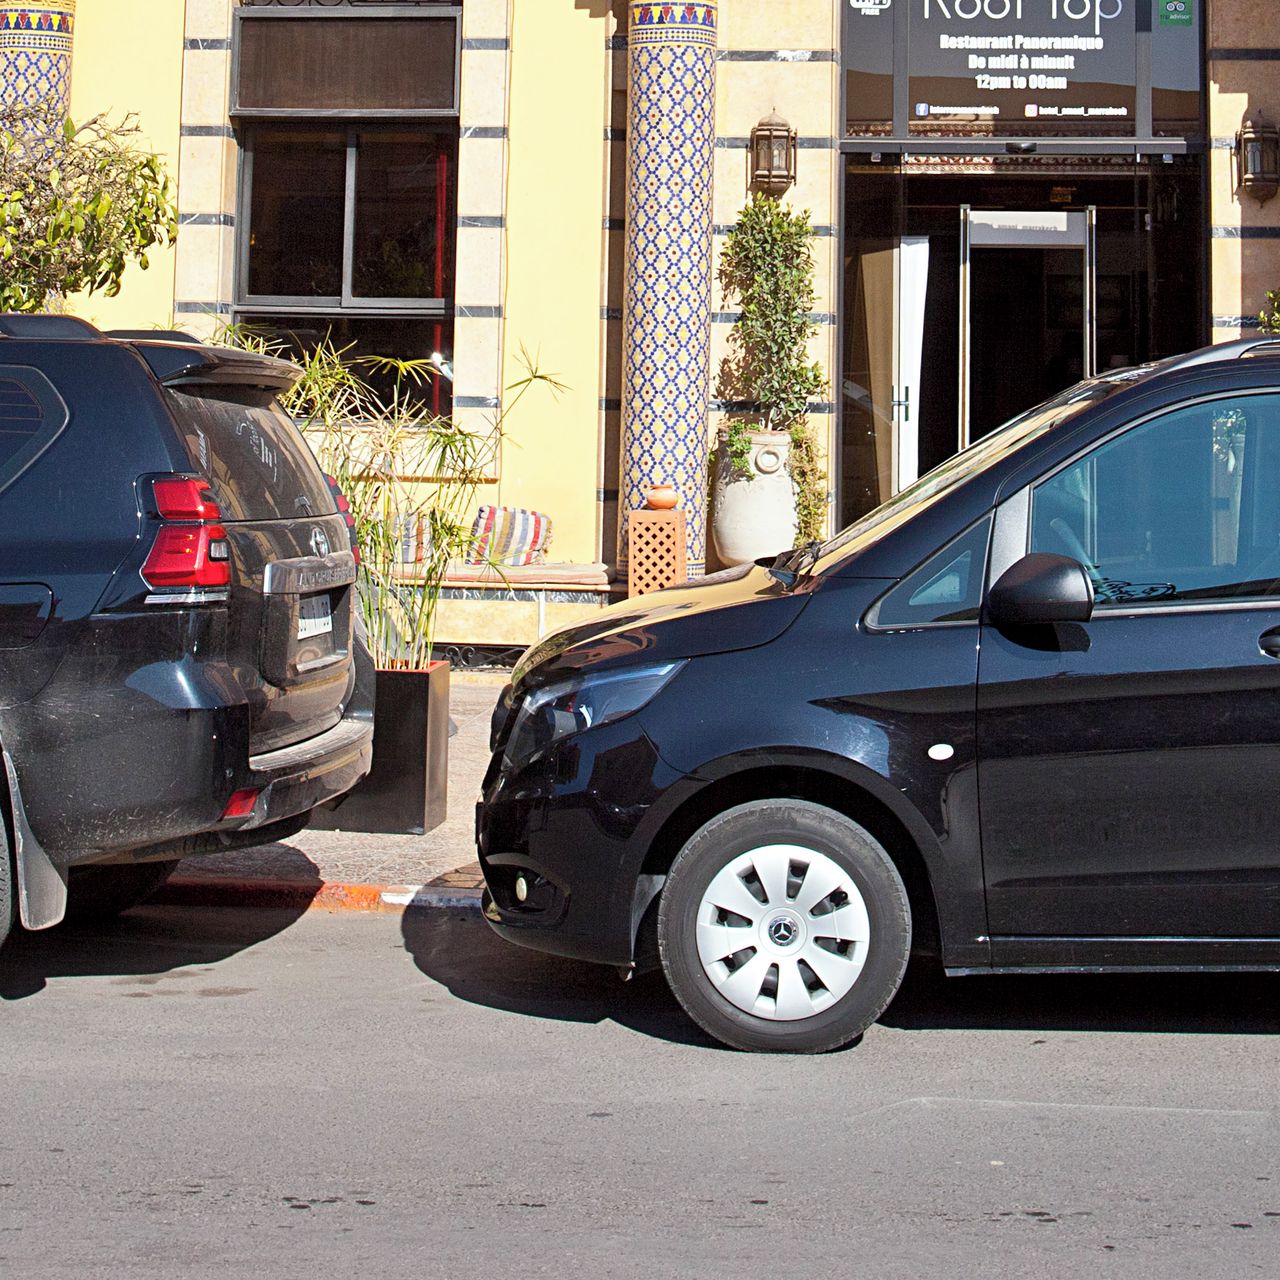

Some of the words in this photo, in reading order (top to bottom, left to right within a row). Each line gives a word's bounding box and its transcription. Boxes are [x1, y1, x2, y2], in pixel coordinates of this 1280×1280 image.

[940, 35, 1013, 49] Restaurant
[1015, 35, 1103, 51] Panoramique
[969, 55, 986, 69] De
[988, 54, 1019, 69] midi
[1020, 53, 1029, 69] à
[1031, 55, 1075, 69] minuit
[975, 74, 1011, 90] 12pm
[1013, 75, 1027, 89] to
